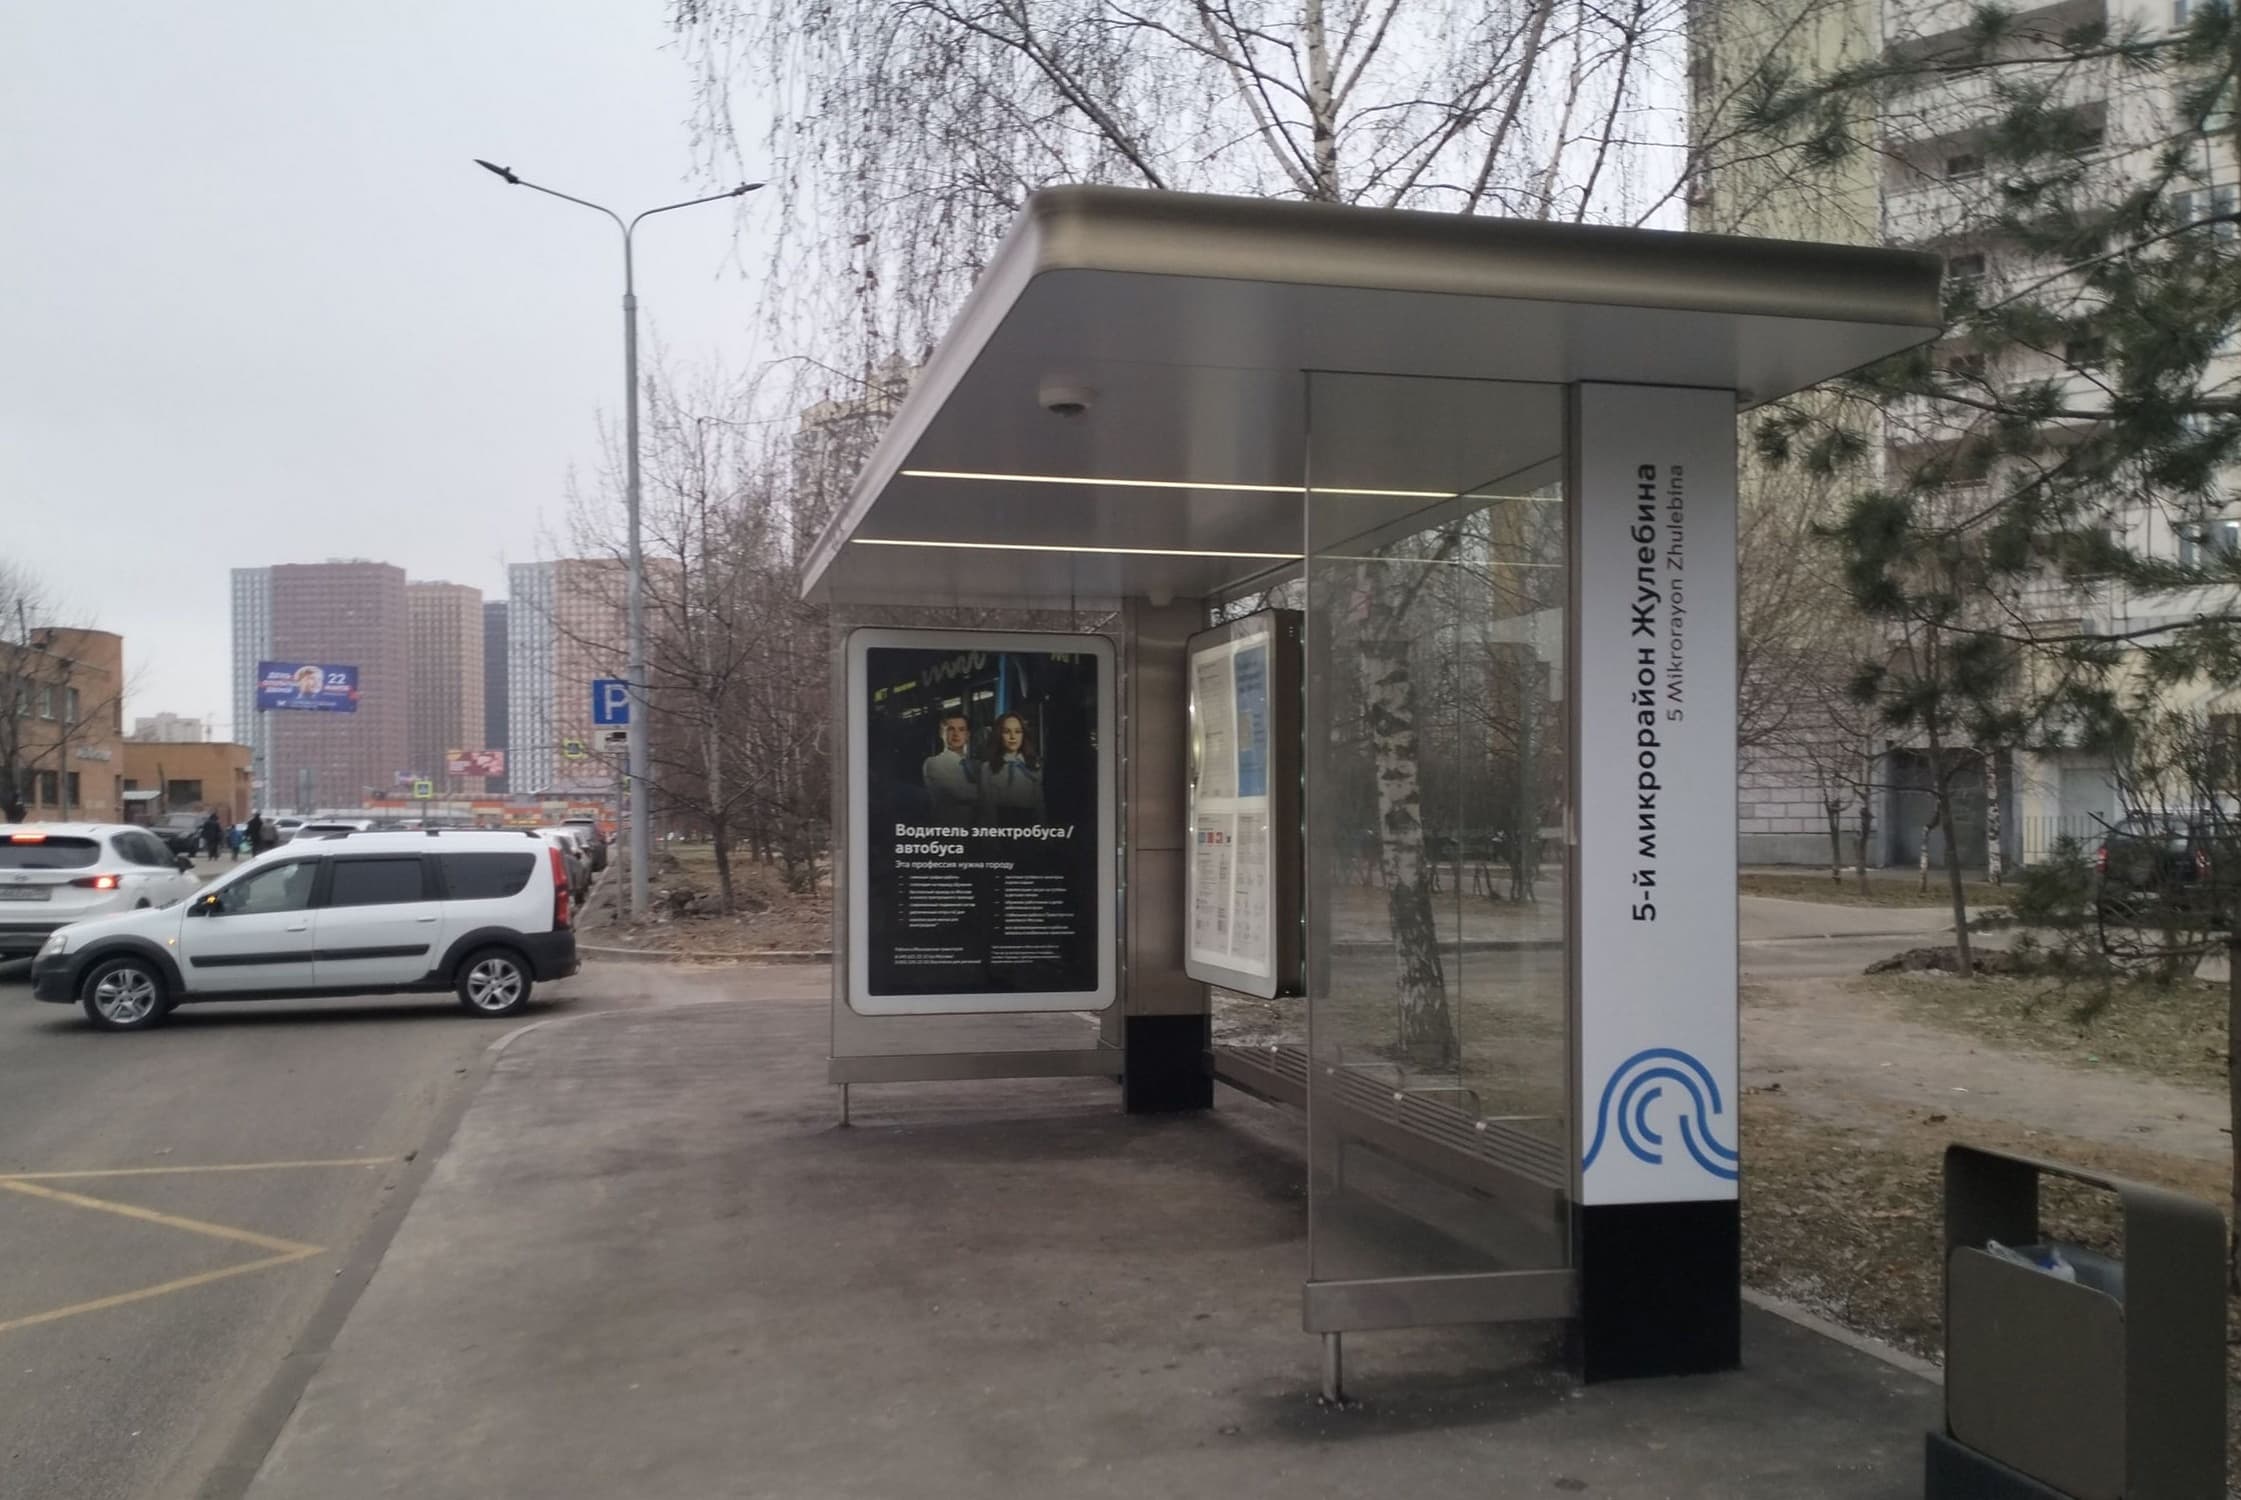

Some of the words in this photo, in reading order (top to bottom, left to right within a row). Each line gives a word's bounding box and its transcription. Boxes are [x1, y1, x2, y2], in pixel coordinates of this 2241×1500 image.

[1666, 465, 1684, 571] Zhulebina
[1631, 464, 1661, 639] Жулебина
[1666, 579, 1687, 703] Mikrorayon
[327, 673, 346, 685] 22
[604, 684, 629, 721] P
[1667, 708, 1684, 722] 5
[1632, 647, 1661, 859] микрорайон
[895, 823, 969, 839] Водитель
[895, 841, 964, 857] автобуса
[911, 859, 957, 870] профессия
[1632, 870, 1656, 922] 5-й
